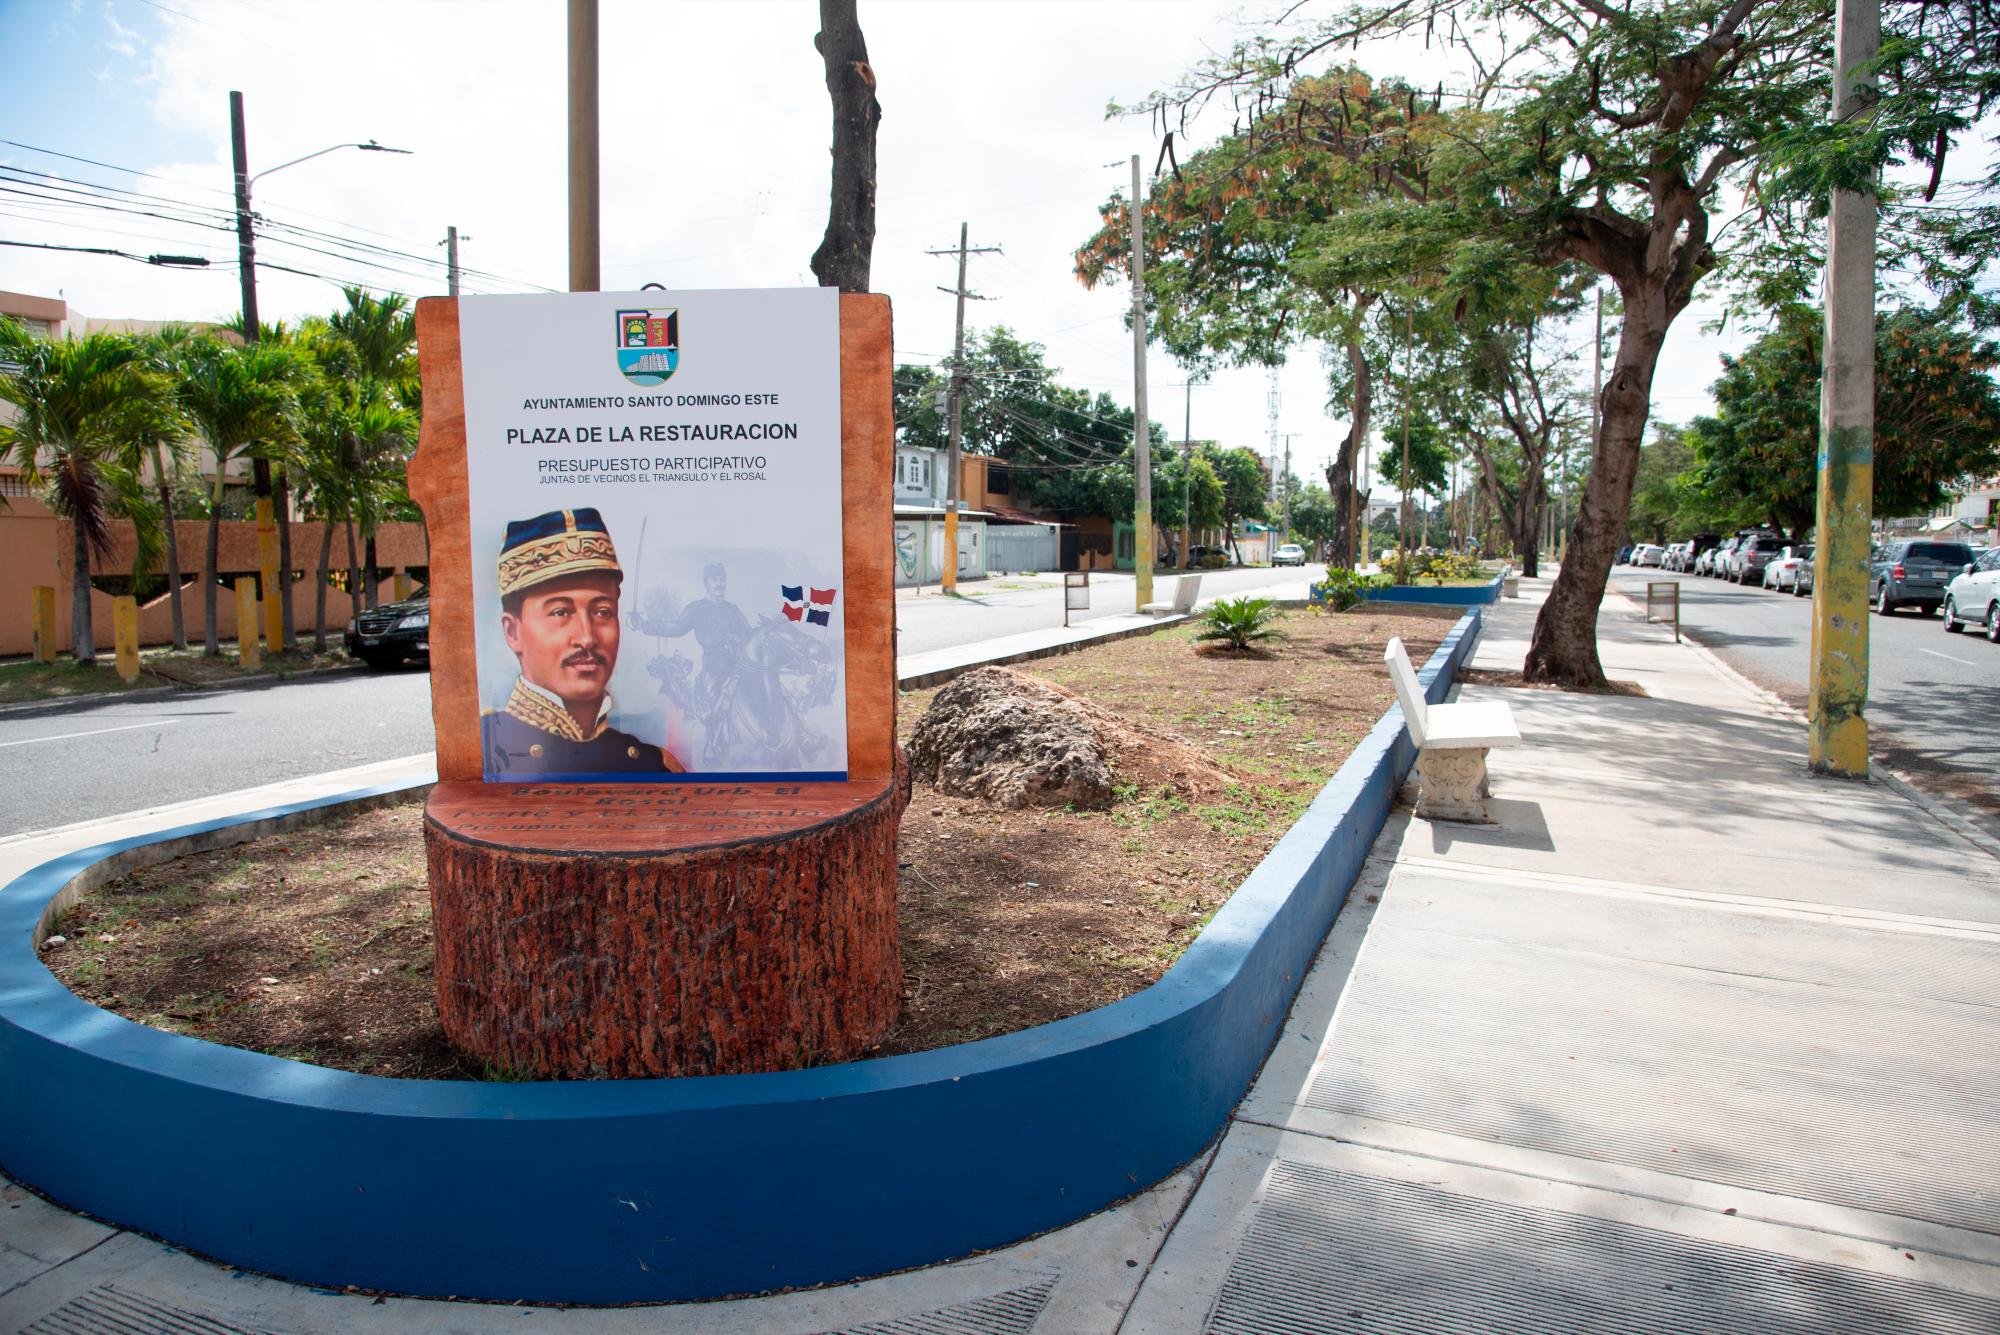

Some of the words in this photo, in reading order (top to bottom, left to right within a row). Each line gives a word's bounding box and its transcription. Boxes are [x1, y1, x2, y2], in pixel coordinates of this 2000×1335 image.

[523, 396, 625, 410] AYUNTAMIENTO
[627, 395, 674, 408] SANTO
[676, 394, 741, 407] DOMINGO
[744, 393, 780, 406] ESTE
[506, 427, 572, 445] PLAZA
[576, 426, 603, 443] DE
[608, 425, 635, 443] LA
[639, 423, 798, 442] RESTAURACION
[538, 457, 651, 473] PRESUPUESTO
[655, 455, 767, 471] PARTICIPATIVO
[538, 475, 576, 485] JUNTAS
[577, 474, 591, 484] DE
[593, 473, 637, 483] VECINOS
[638, 473, 651, 483] EL
[652, 472, 709, 482] TRIANGULO
[710, 472, 718, 481] Y
[719, 472, 732, 481] EL
[733, 471, 767, 481] ROSAL
[512, 786, 681, 796] Boulevard
[595, 796, 688, 805] Rosal
